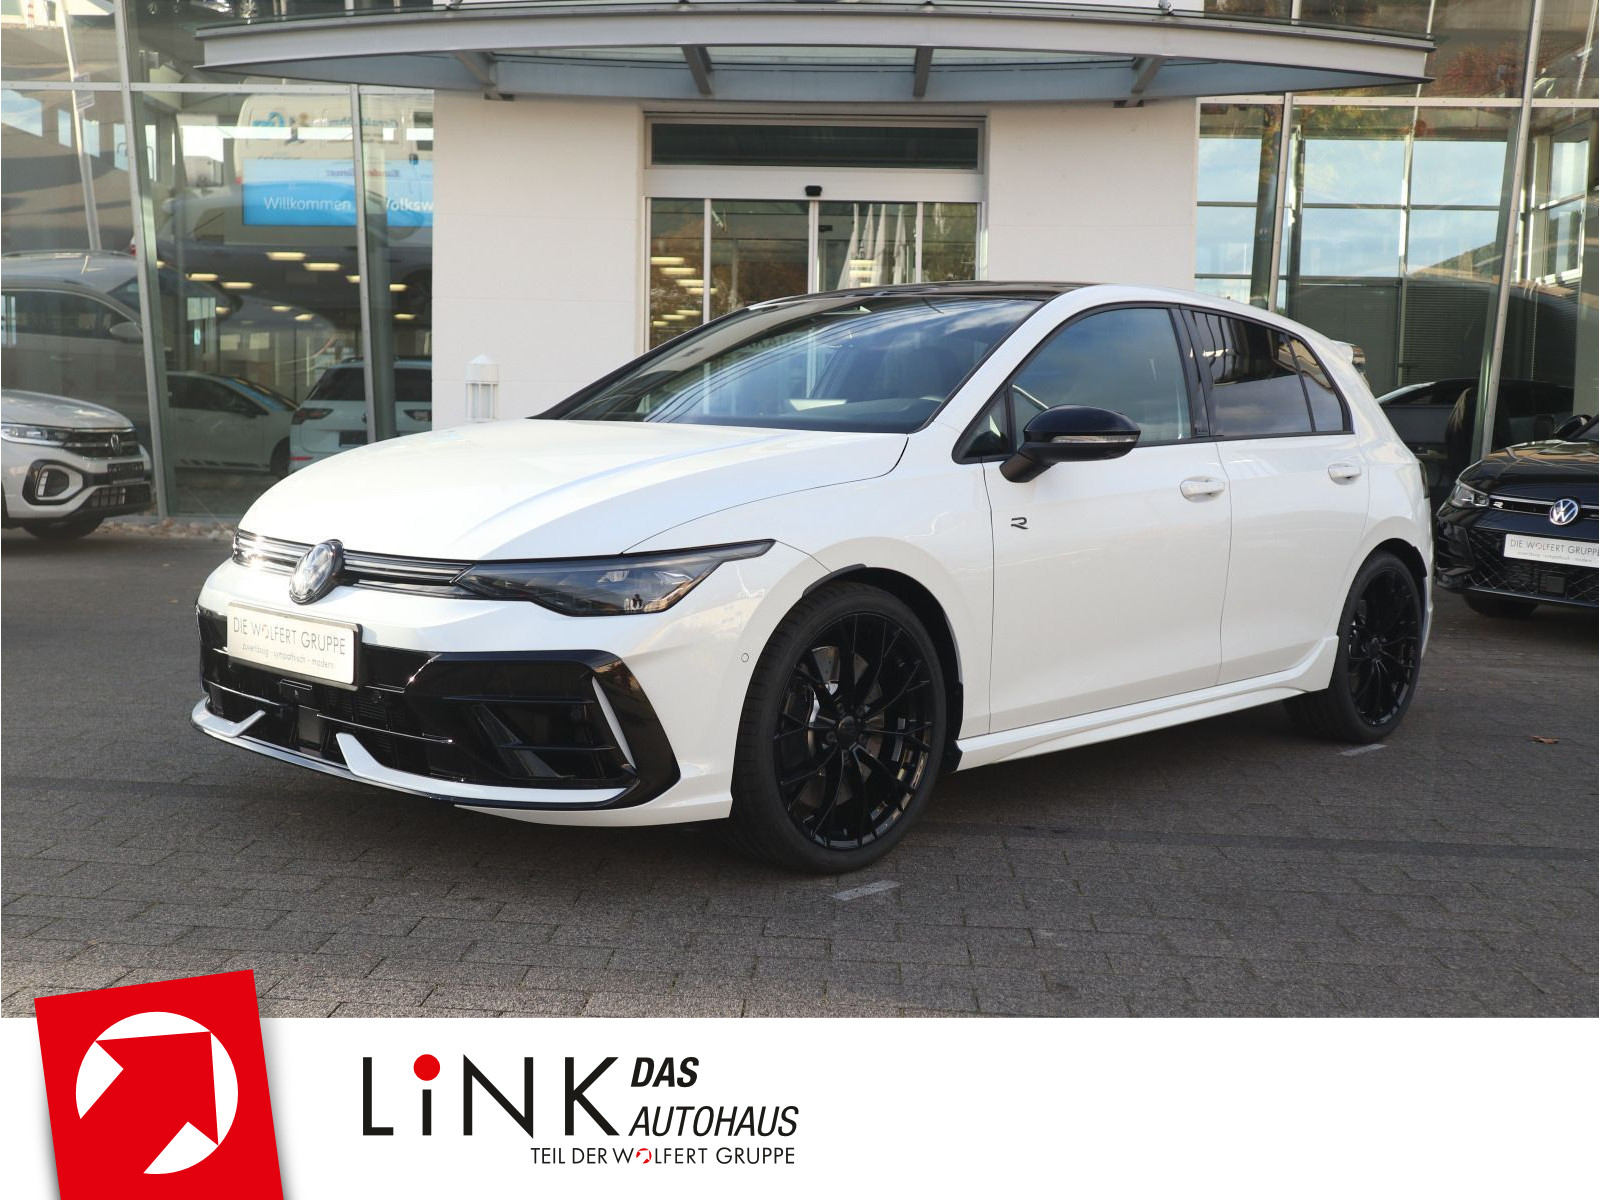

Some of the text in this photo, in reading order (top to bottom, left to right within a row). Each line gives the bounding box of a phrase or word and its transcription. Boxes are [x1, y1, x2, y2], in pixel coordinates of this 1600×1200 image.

[263, 196, 352, 210] Willkommen
[1010, 516, 1029, 530] R
[1510, 539, 1522, 549] DIE
[1526, 541, 1565, 553] WOLFERT
[233, 617, 346, 655] DIE WOLFERT GRUPPE
